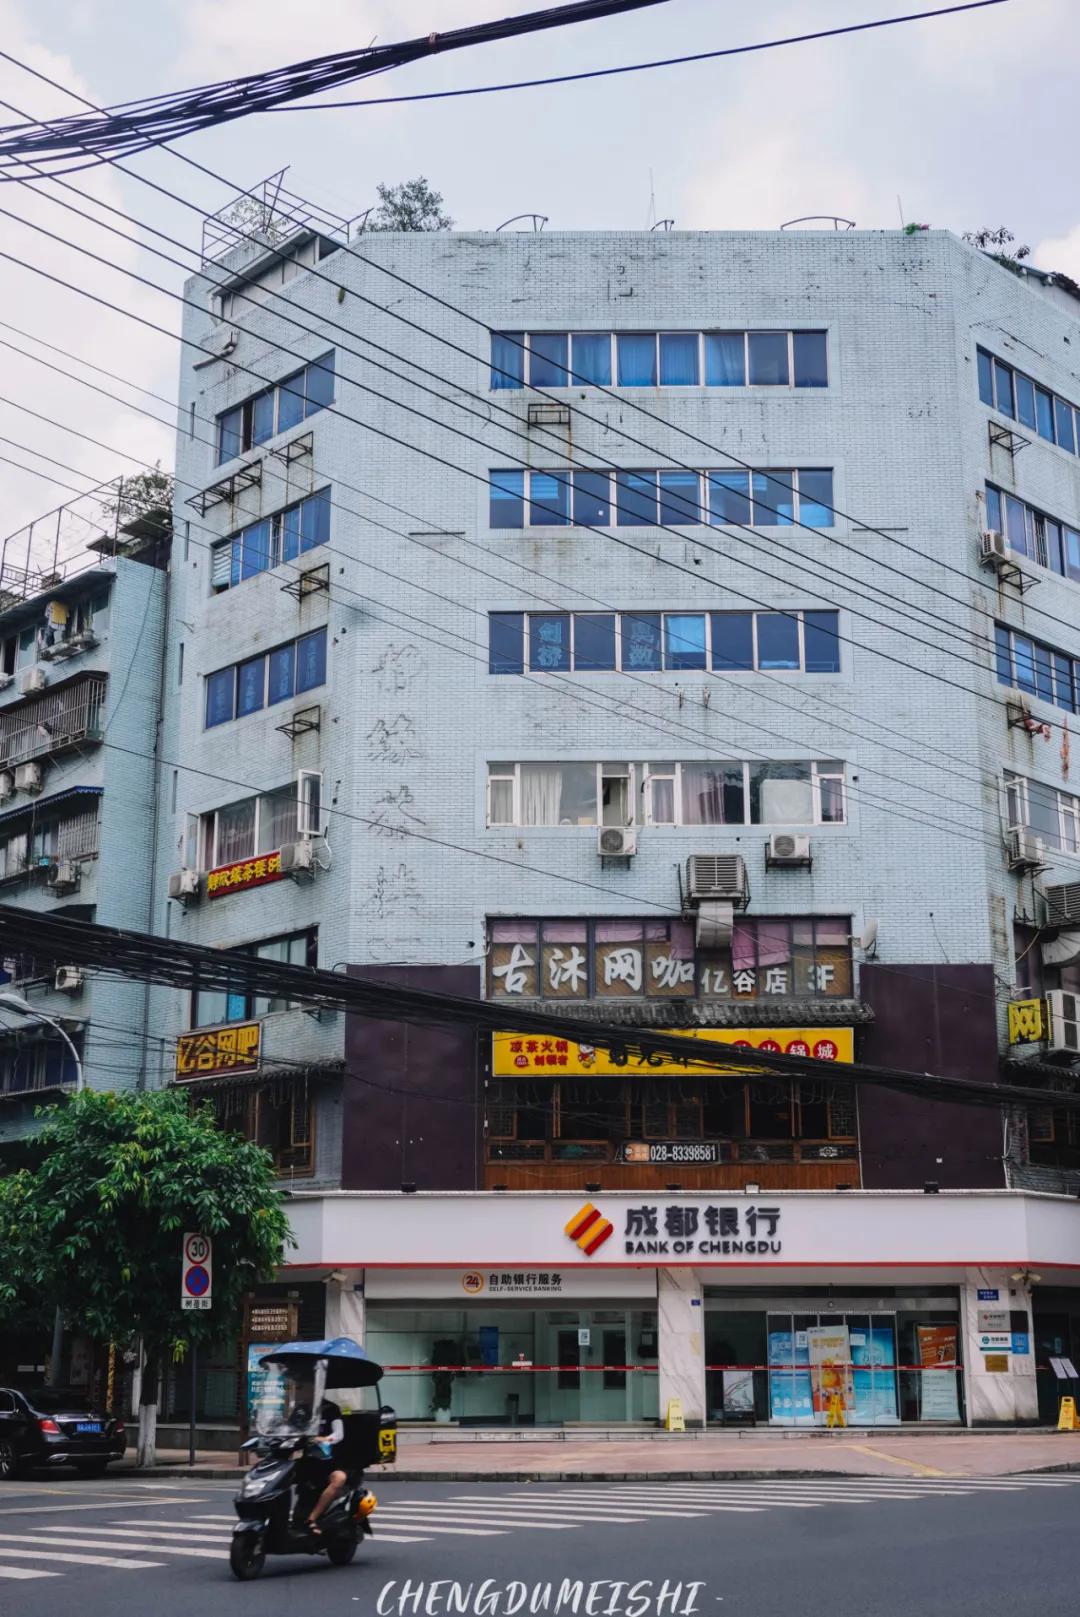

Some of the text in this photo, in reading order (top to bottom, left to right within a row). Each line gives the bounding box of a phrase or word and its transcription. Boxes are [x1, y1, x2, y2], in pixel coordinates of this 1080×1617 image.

[701, 968, 788, 995] 亿谷店
[807, 964, 835, 992] 3F
[177, 1025, 259, 1074] 亿谷网吧
[651, 1145, 716, 1161] 028-83398581
[625, 1206, 781, 1237] 成都银行
[191, 1241, 204, 1257] 30
[625, 1241, 781, 1254] BANK OF CHENGDU
[466, 1273, 562, 1287] 24 自助银行服务
